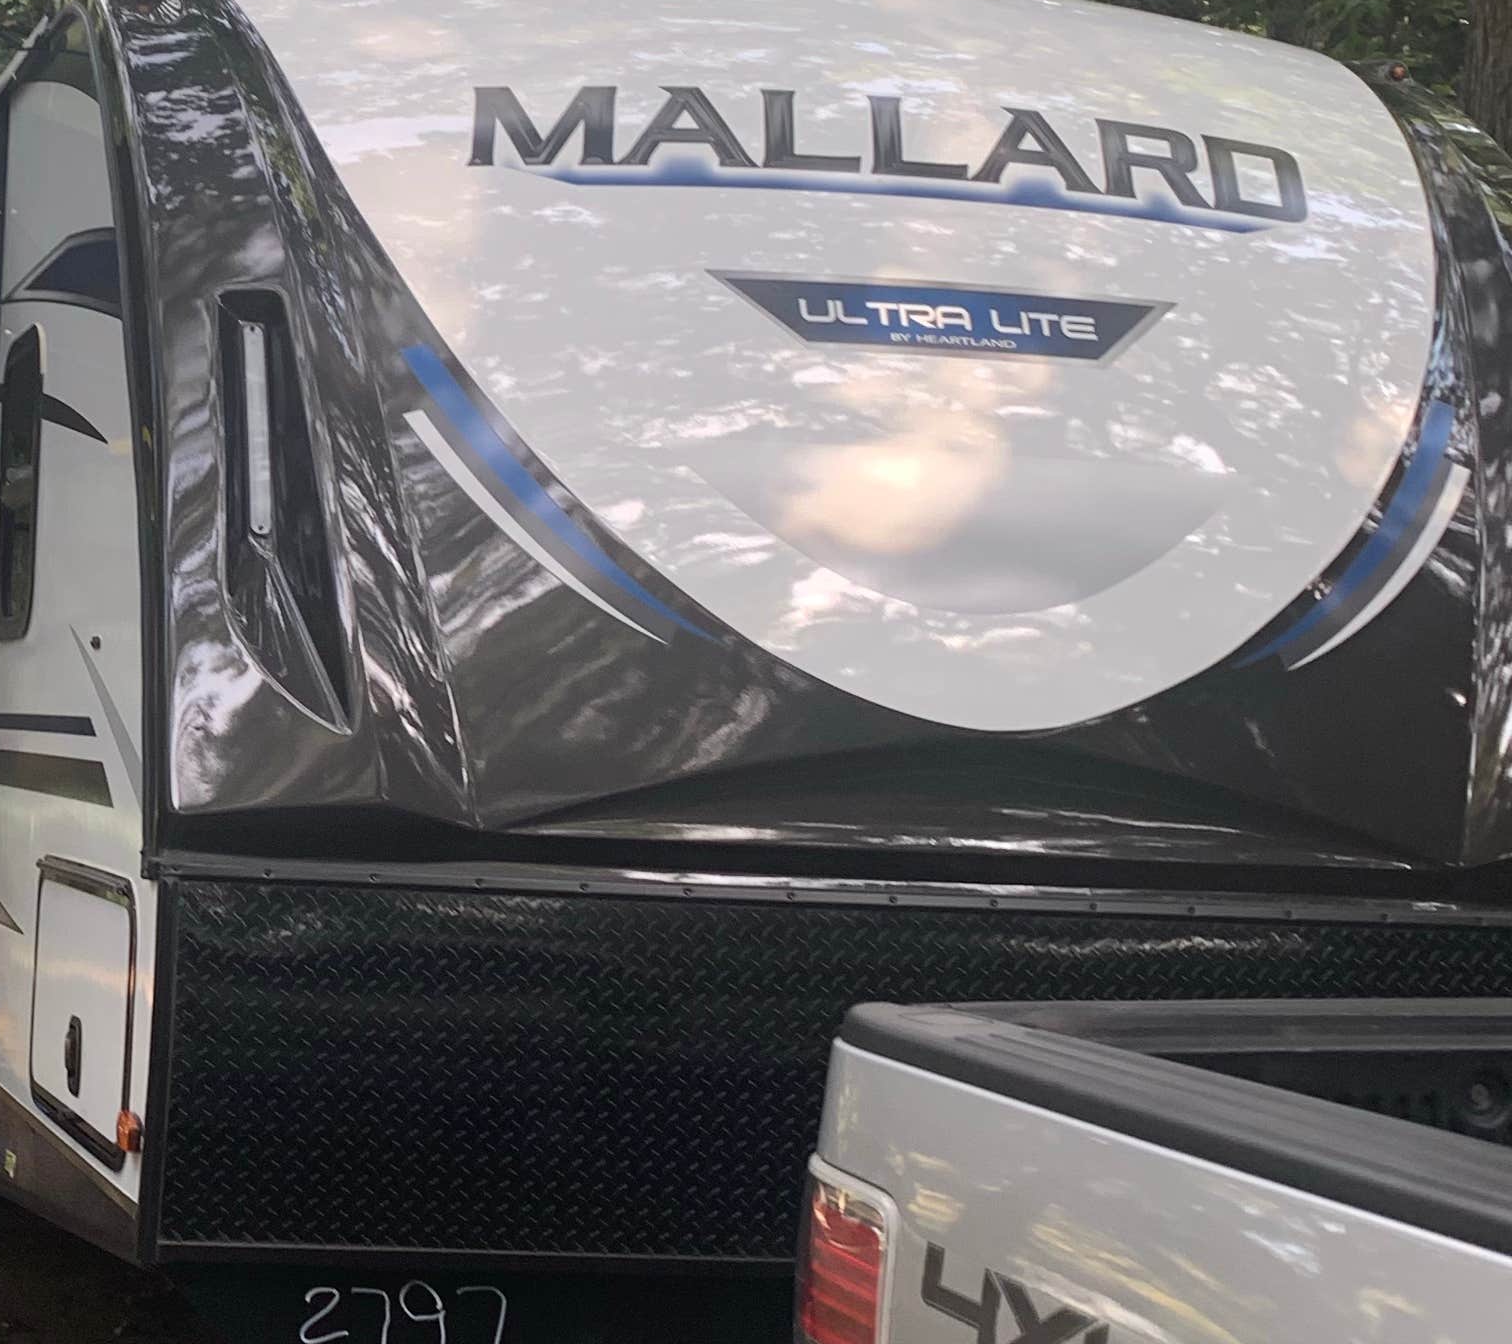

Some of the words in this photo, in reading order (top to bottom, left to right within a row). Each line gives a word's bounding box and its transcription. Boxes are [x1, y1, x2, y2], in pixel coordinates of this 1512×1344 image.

[466, 85, 1307, 224] MALLARD
[797, 297, 973, 331] ULTRA
[990, 308, 1099, 342] LITE
[890, 331, 912, 344] BY
[916, 331, 1018, 350] HEARTLAND
